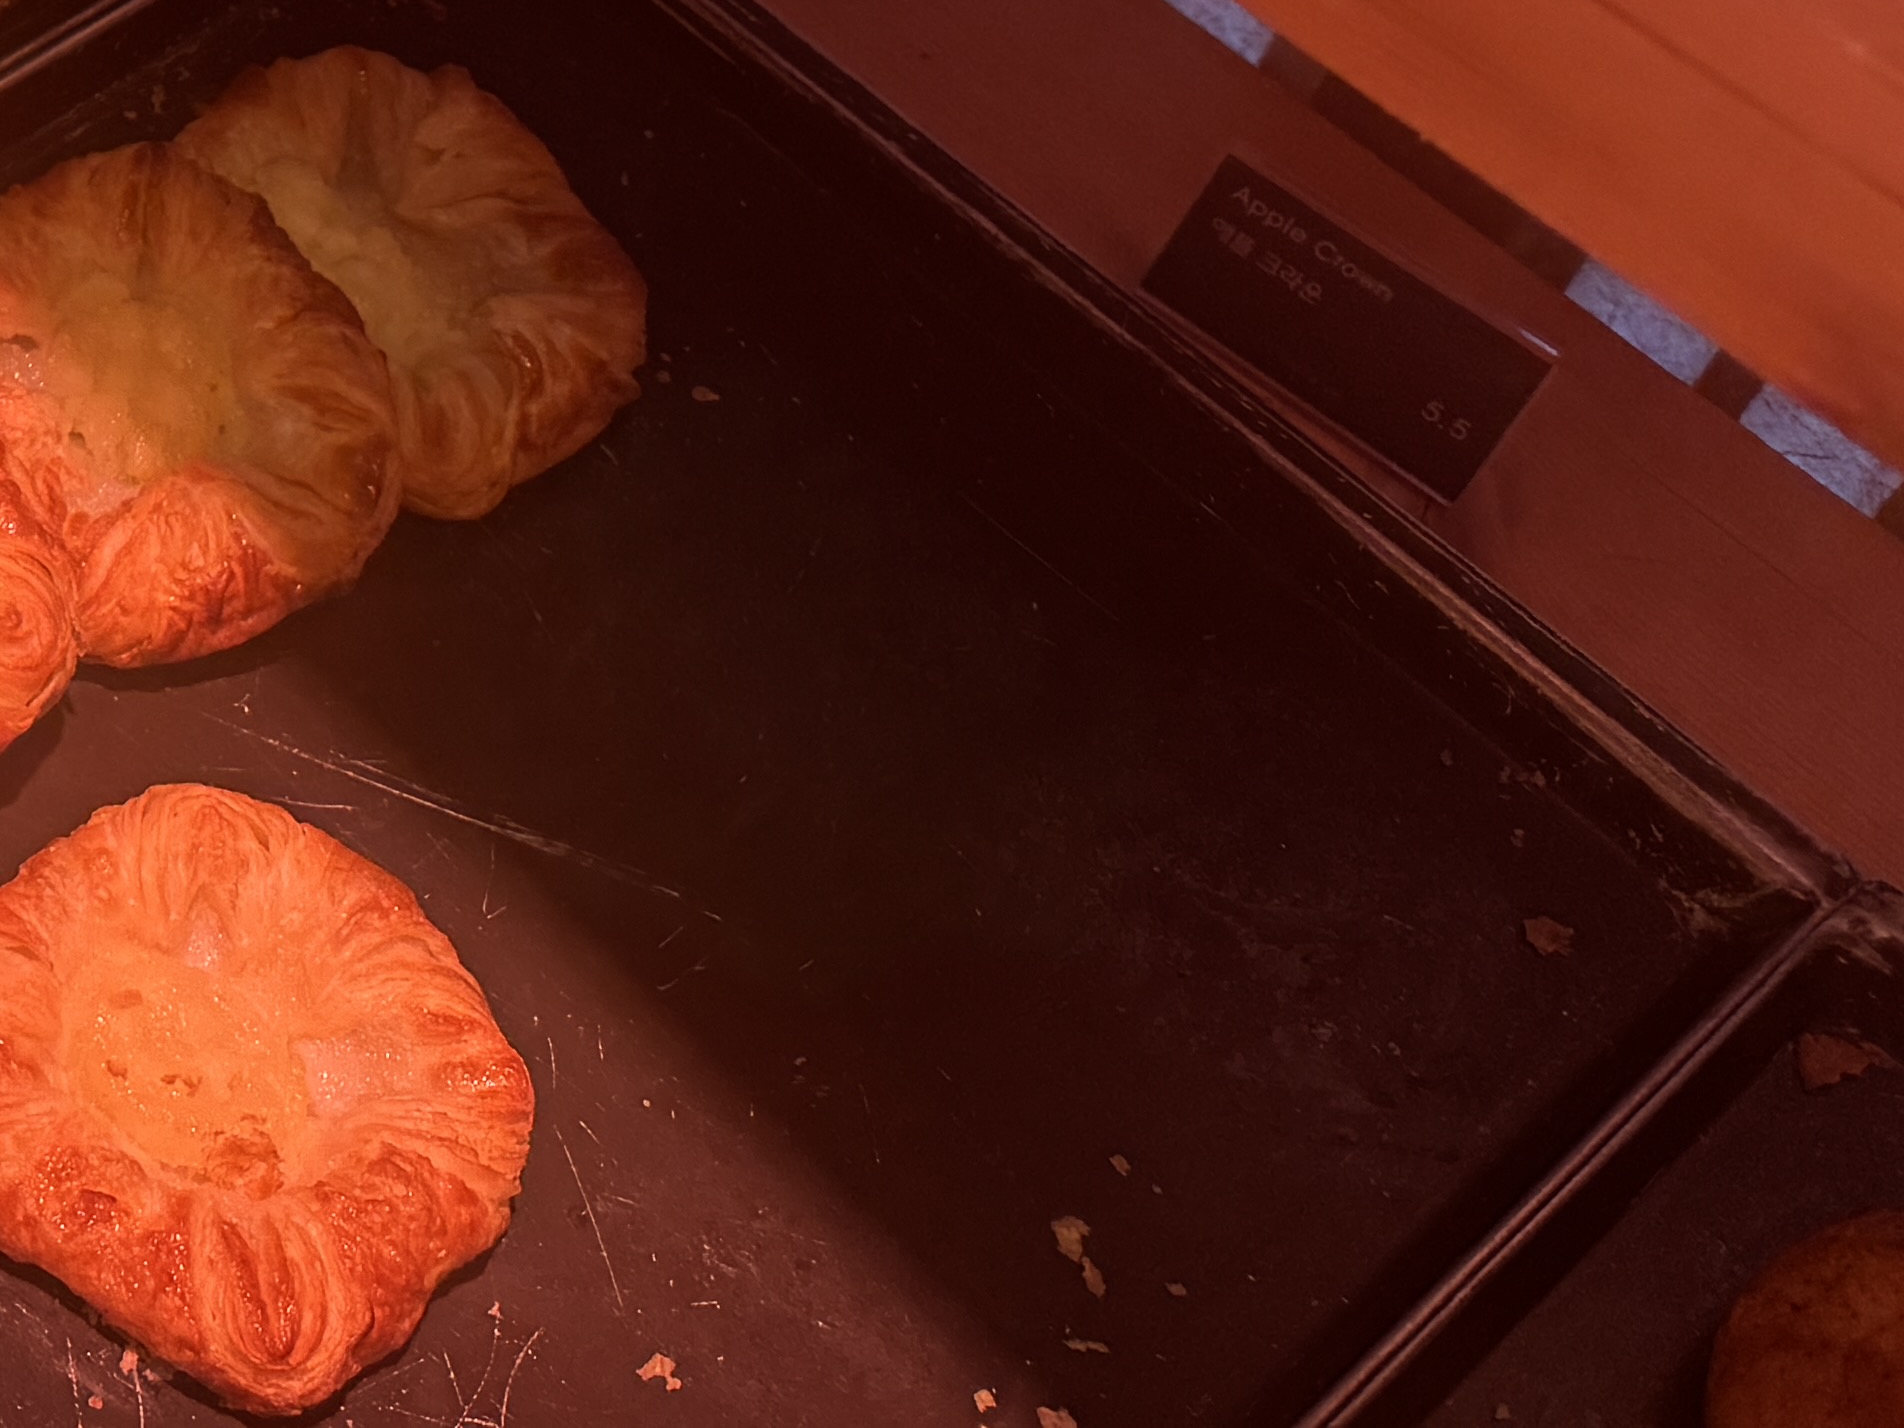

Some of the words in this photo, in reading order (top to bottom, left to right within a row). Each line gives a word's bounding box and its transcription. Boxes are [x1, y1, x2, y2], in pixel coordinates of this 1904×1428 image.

[1230, 185, 1308, 244] Apple
[1312, 239, 1394, 302] Crown
[1255, 250, 1322, 304] 크라운
[1420, 399, 1472, 441] 5.5
